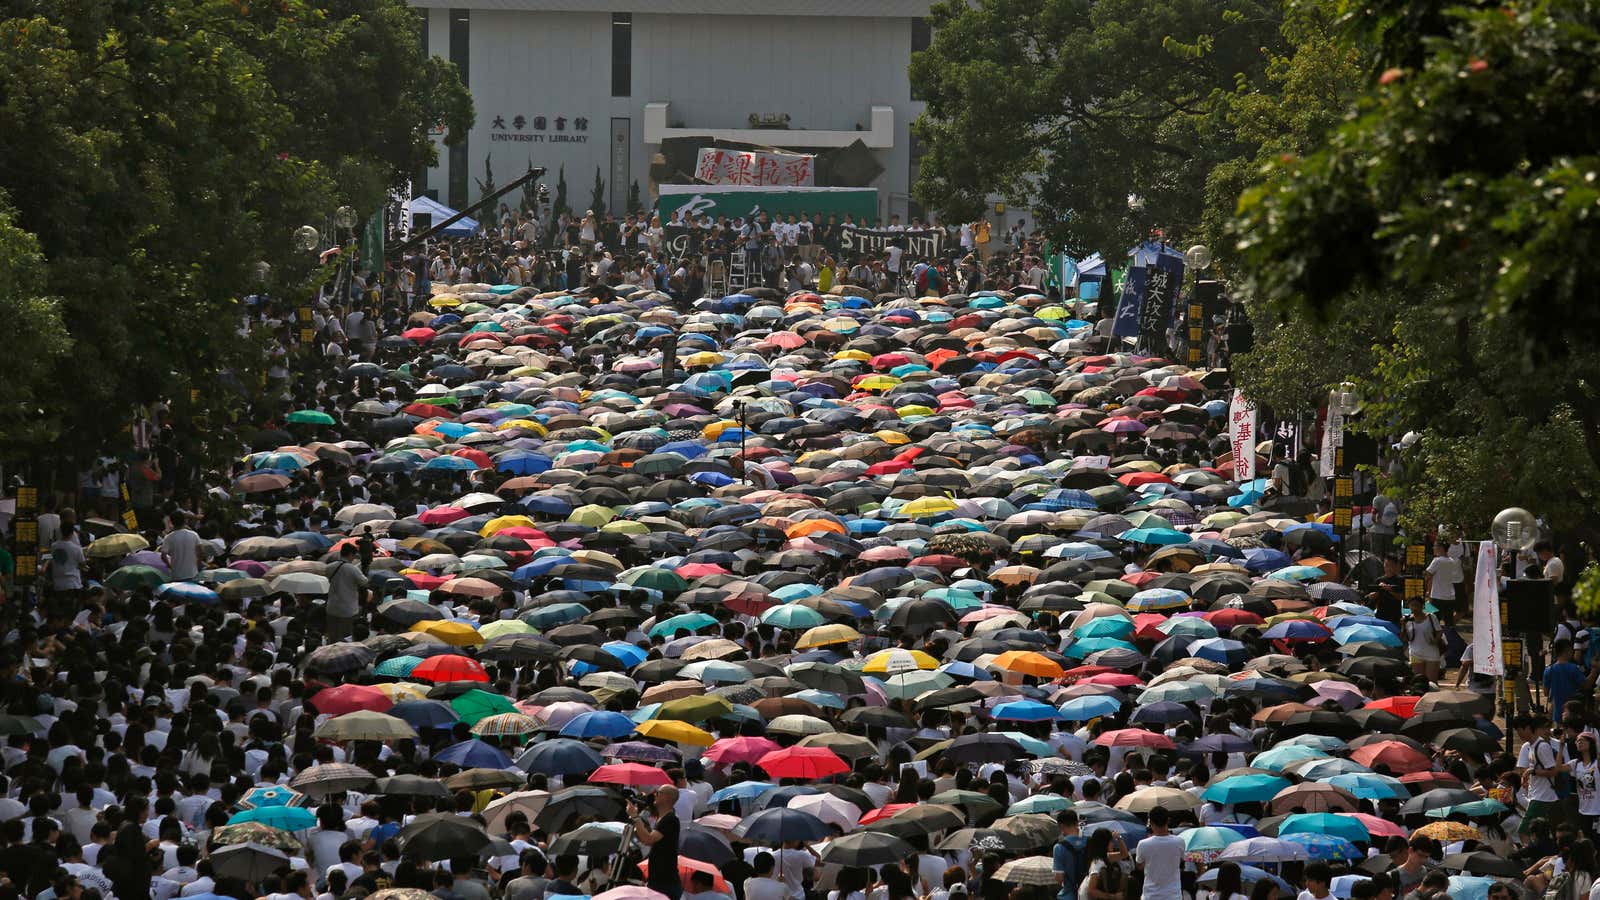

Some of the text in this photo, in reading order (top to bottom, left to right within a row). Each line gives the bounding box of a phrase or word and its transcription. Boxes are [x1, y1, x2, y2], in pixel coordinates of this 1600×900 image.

[491, 115, 589, 131] 大學圖書館
[491, 133, 589, 143] UNIVERSITY LIBRARY
